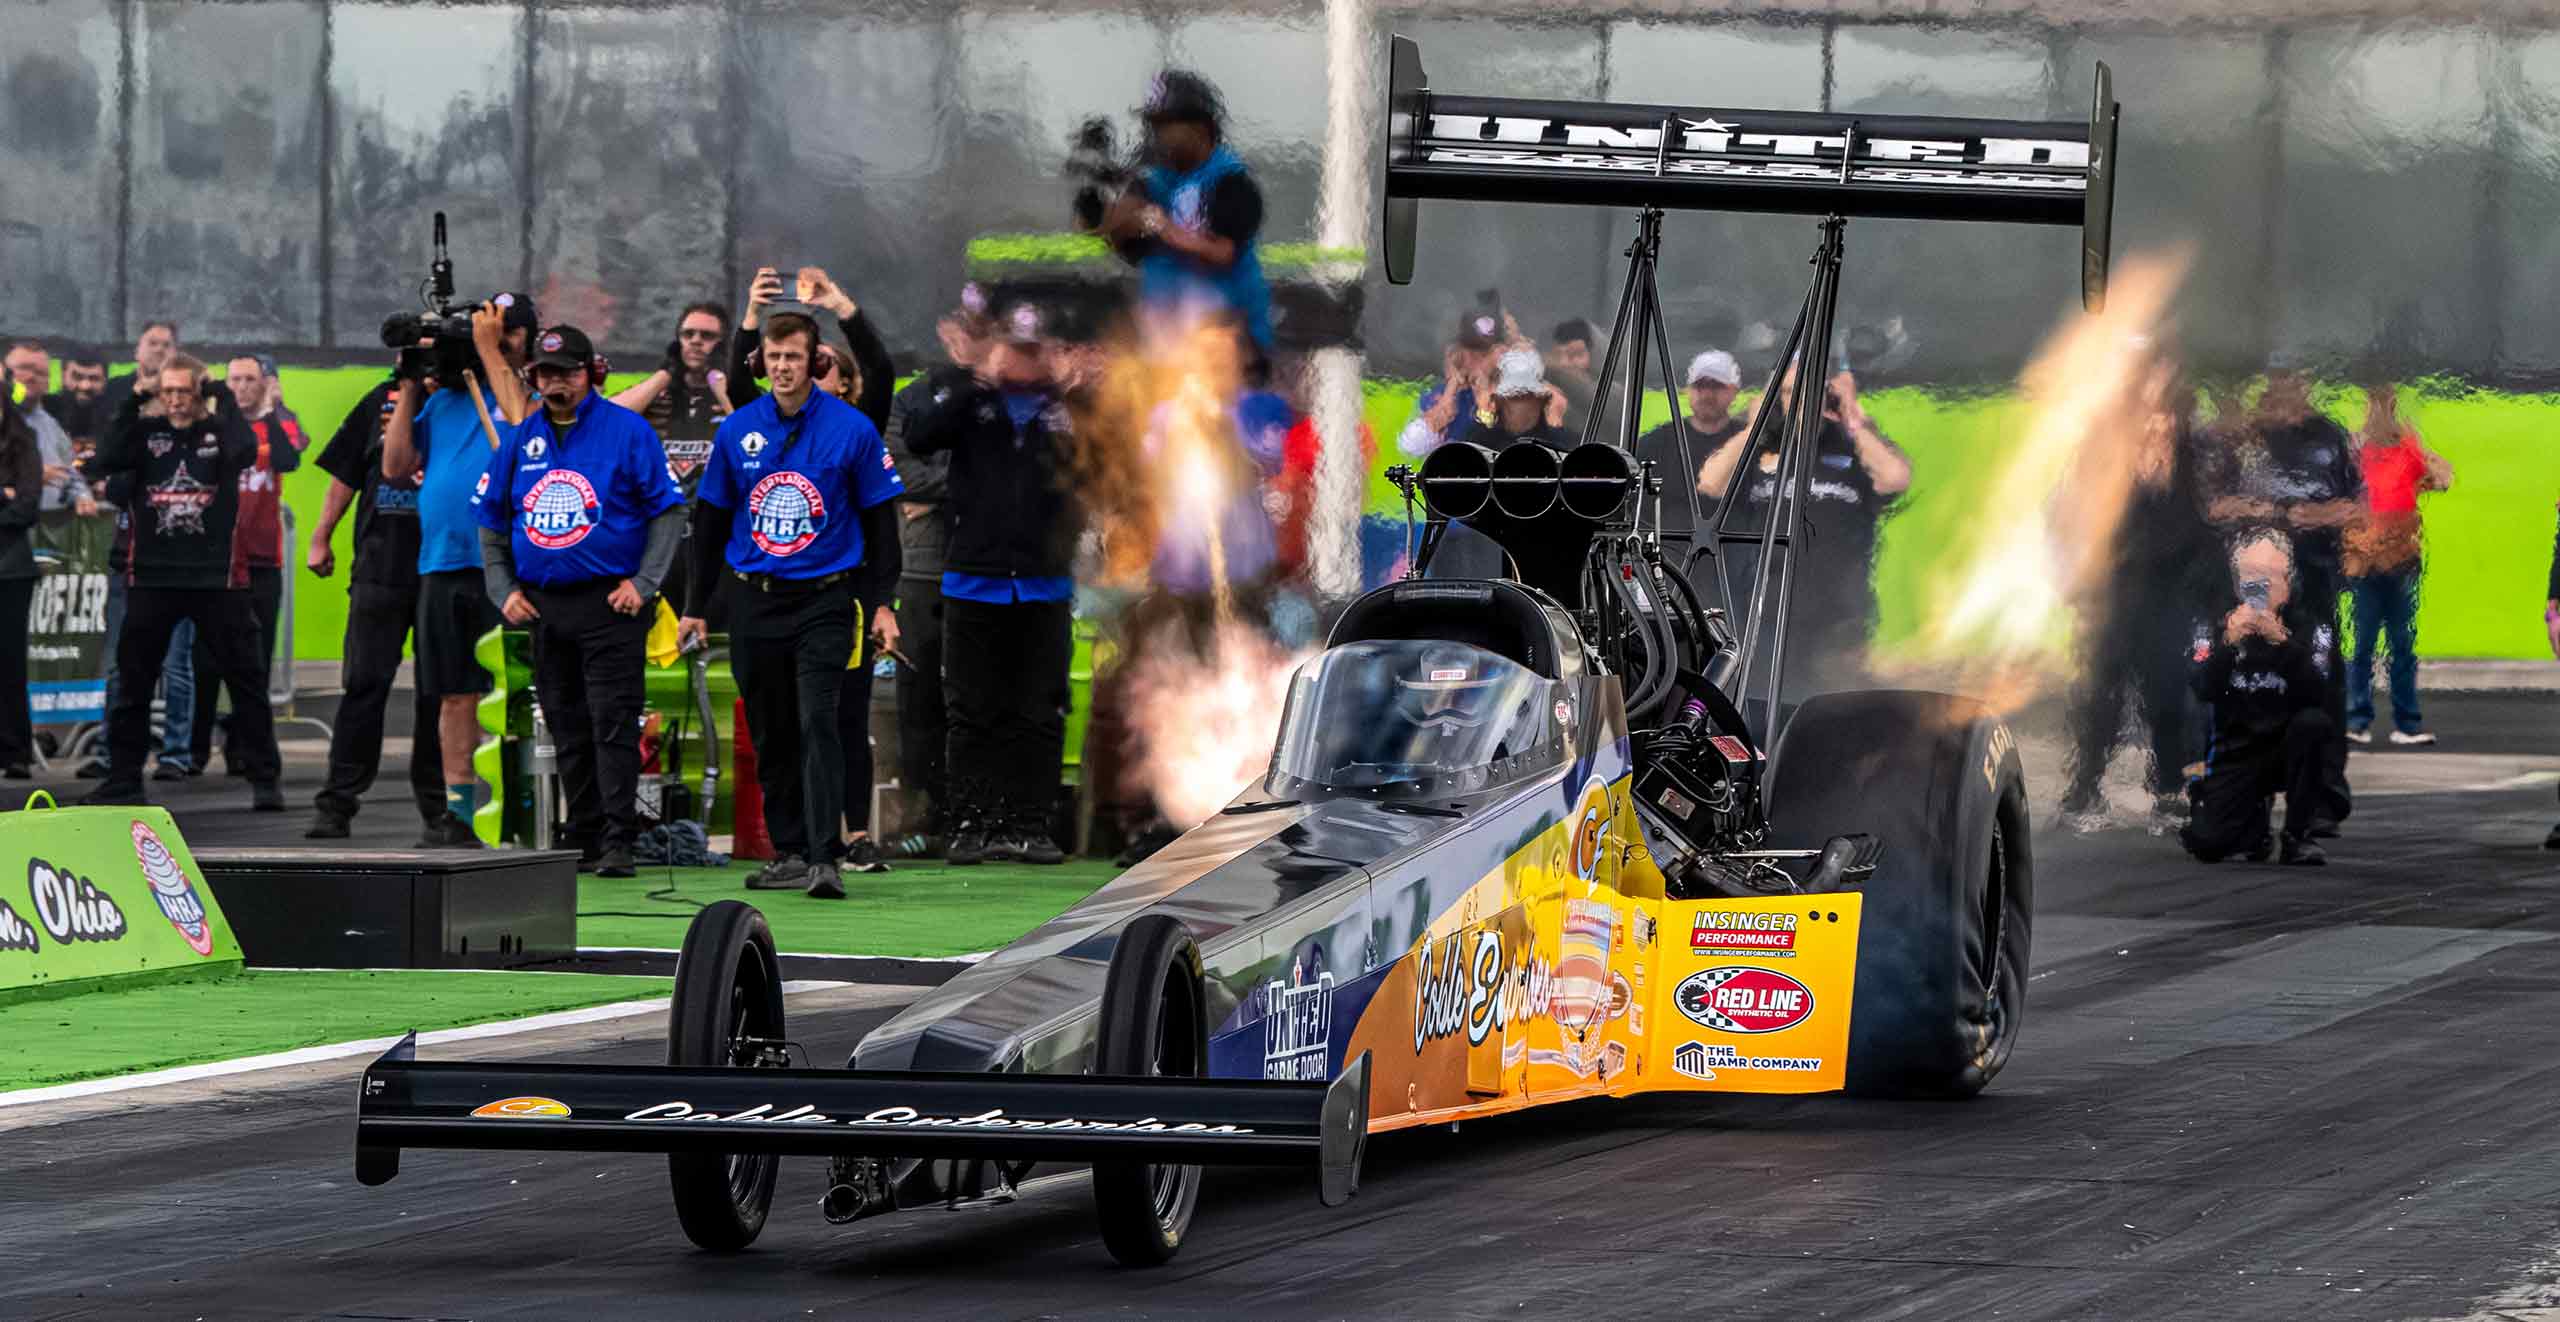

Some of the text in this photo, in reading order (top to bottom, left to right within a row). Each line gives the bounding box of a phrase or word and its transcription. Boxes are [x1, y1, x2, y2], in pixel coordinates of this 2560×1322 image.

[1429, 114, 2088, 167] UNITED
[750, 473, 822, 511] INTERNATIONAL
[525, 512, 590, 528] IHRA
[753, 516, 815, 536] IHRA
[30, 862, 125, 940] Ohio
[157, 891, 203, 924] IHRA
[1694, 911, 1798, 931] INSINGER
[1697, 933, 1789, 946] PERFORMANCE
[1715, 988, 1803, 1011] RED LINE
[1728, 1009, 1789, 1018] SYNTHETIC OIL
[1708, 1046, 1734, 1056] THE
[1301, 1053, 1324, 1079] DOOR
[1708, 1057, 1820, 1070] BAMR COMPANY
[624, 1102, 1255, 1134] Coble Enterprises
